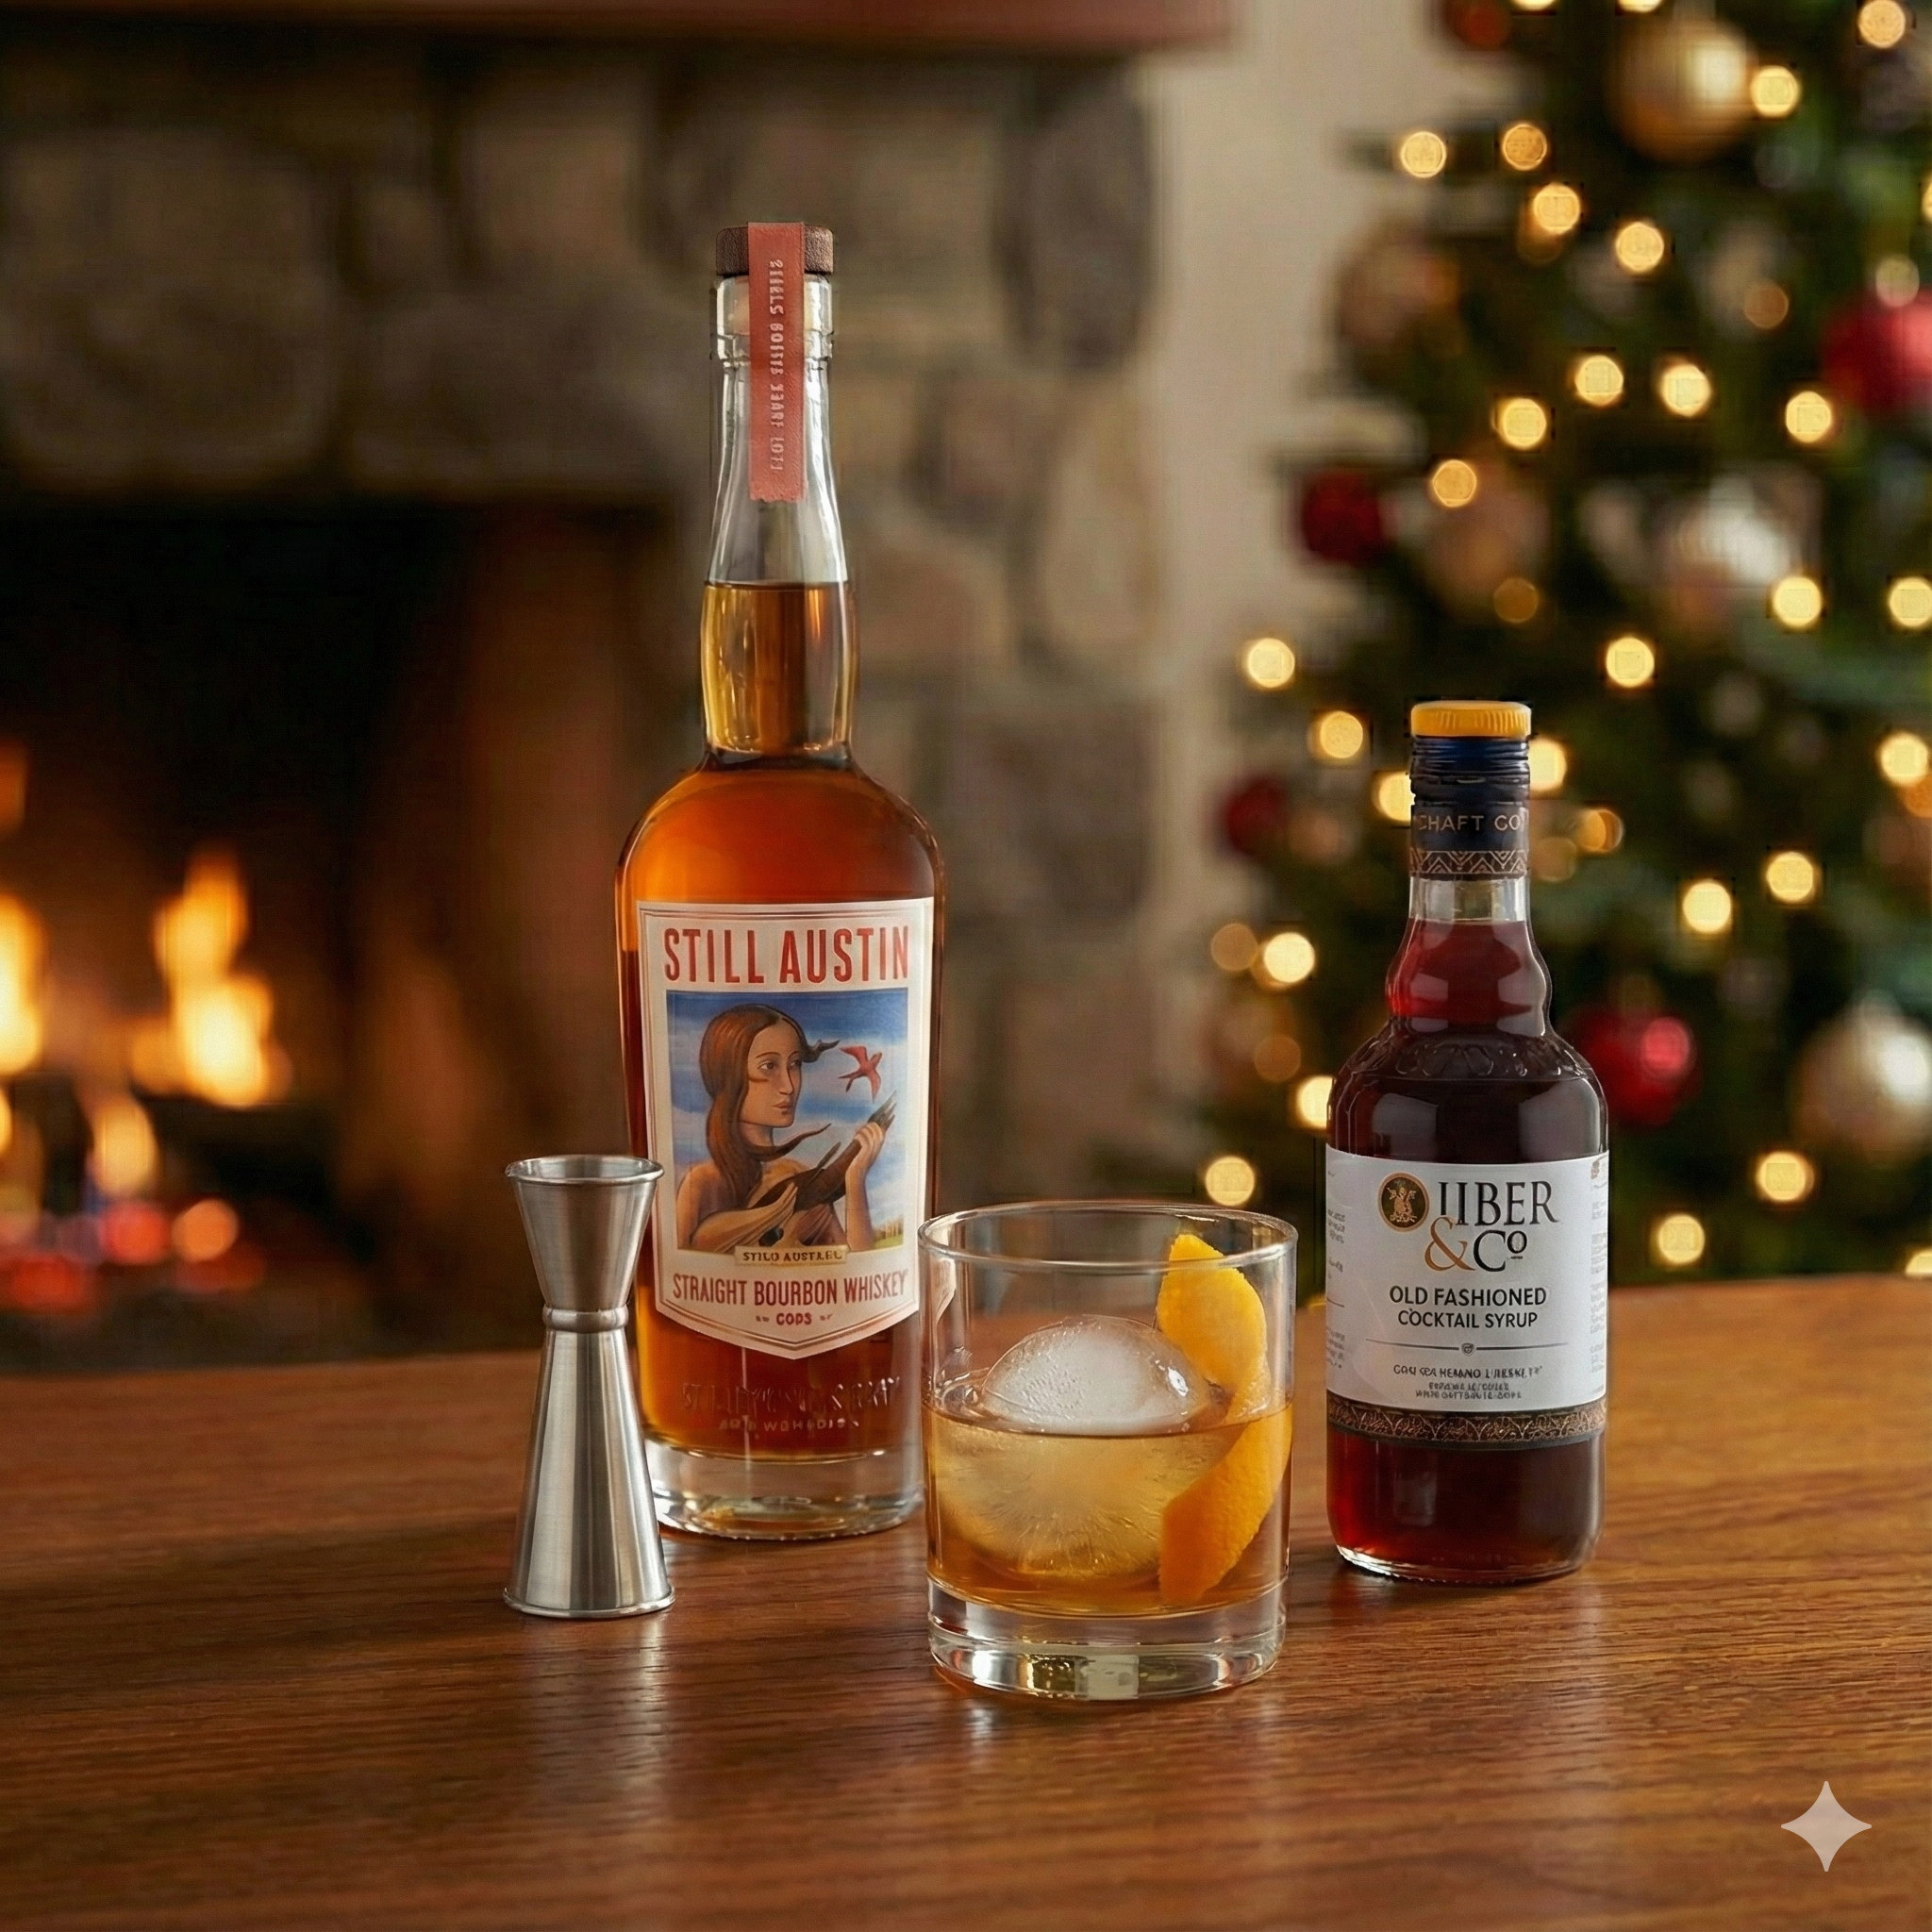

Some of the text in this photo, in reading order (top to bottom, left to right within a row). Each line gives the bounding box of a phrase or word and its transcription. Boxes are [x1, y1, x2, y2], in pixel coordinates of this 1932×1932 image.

[663, 925, 908, 984] STILL AUSTIN
[673, 1270, 907, 1307] STRAIGHT BOURBON WHISKEY
[1390, 1285, 1547, 1307] OLD FASHIONED
[1398, 1308, 1538, 1328] COCKTAIL SYRUP
